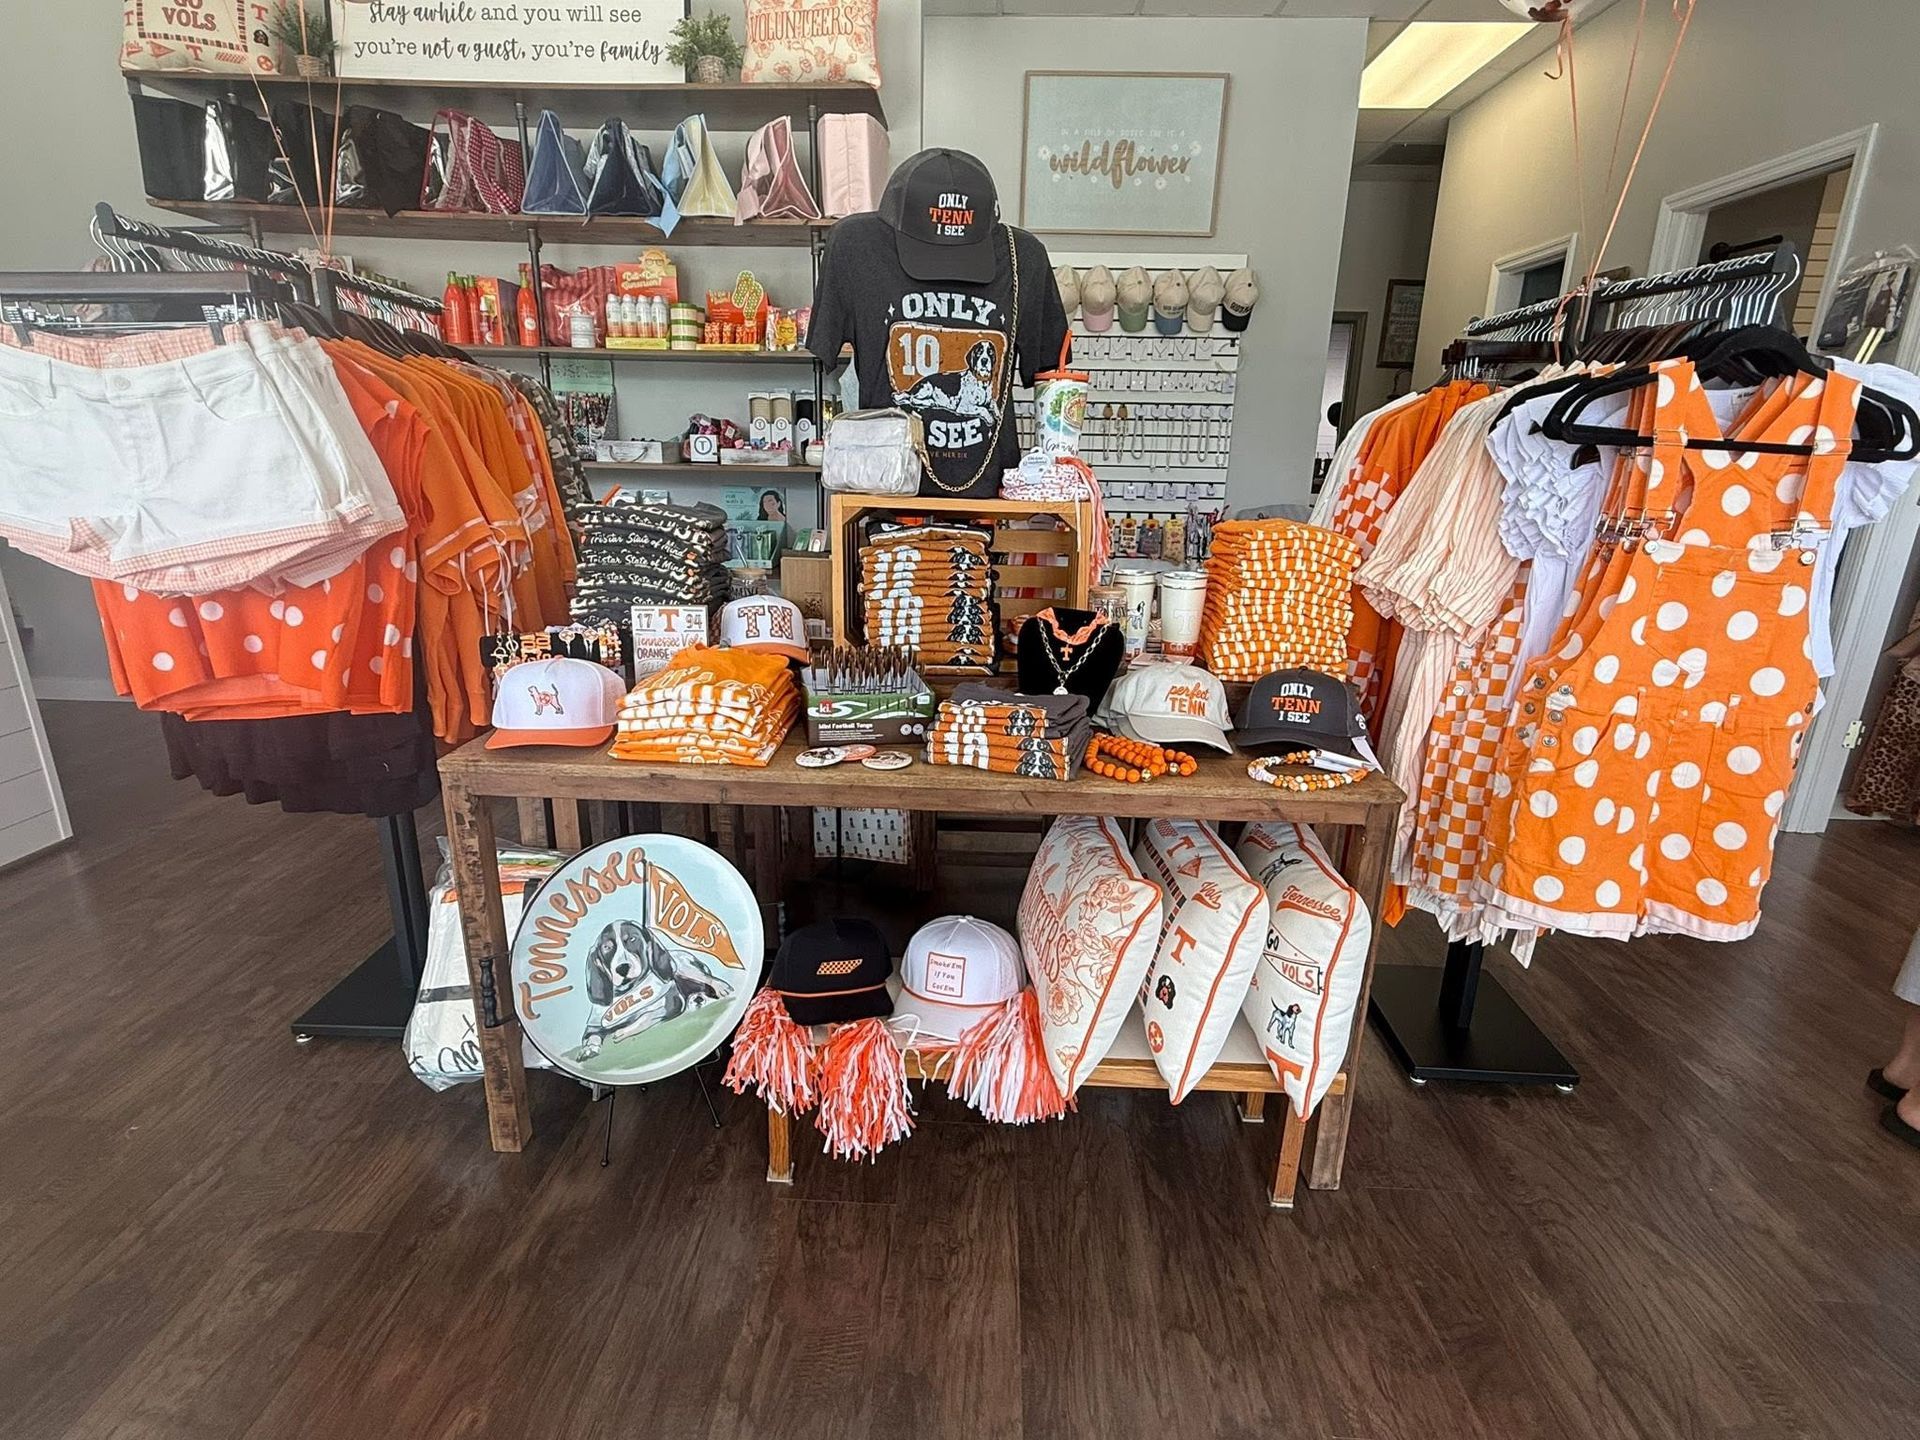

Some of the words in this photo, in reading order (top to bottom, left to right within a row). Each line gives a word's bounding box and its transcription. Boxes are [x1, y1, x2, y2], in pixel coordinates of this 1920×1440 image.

[161, 7, 218, 32] VOLS
[413, 1, 476, 24] awhile
[481, 4, 518, 21] and
[523, 7, 561, 25] you
[566, 5, 604, 22] will
[609, 9, 642, 23] see
[750, 6, 854, 43] VOLUNTEERS
[185, 44, 203, 61] T
[354, 38, 417, 58] you're
[422, 37, 454, 60] not
[457, 43, 471, 58] a
[473, 38, 526, 62] guest,
[532, 41, 595, 61] you're
[600, 39, 664, 65] family
[1049, 139, 1191, 189] wildflower
[938, 193, 969, 210] ONLY
[929, 207, 974, 225] TENN
[937, 224, 942, 235] I
[944, 225, 965, 236] SEE
[902, 292, 997, 326] ONLY
[899, 333, 940, 377] 10
[928, 418, 983, 449] SEE
[626, 532, 650, 544] State
[650, 538, 662, 549] of
[661, 540, 688, 557] Mind
[587, 554, 622, 565] Tristar
[625, 554, 649, 565] State
[650, 558, 660, 568] of
[662, 560, 687, 573] Mind
[665, 580, 689, 592] Mind
[637, 613, 652, 628] 17
[658, 609, 679, 632] T
[685, 613, 702, 629] 94
[738, 605, 793, 640] TN
[1174, 610, 1199, 635] T
[637, 648, 670, 660] ORANGE
[1060, 647, 1073, 661] T
[1164, 682, 1209, 703] perfect
[1281, 683, 1314, 698] ONLY
[1169, 697, 1206, 716] TENN
[1271, 697, 1321, 714] TENN
[1278, 711, 1284, 720] I
[1287, 711, 1311, 723] SEE
[1167, 835, 1195, 858] T
[1200, 882, 1223, 903] Vols
[1282, 885, 1342, 920] Tennessee
[657, 880, 722, 949] VOLS
[518, 847, 648, 1021] Tennessee
[1170, 925, 1197, 964] T
[1266, 928, 1279, 950] GO
[942, 972, 955, 980] You
[1282, 962, 1314, 988] VOLS
[604, 985, 655, 1022] VOLS
